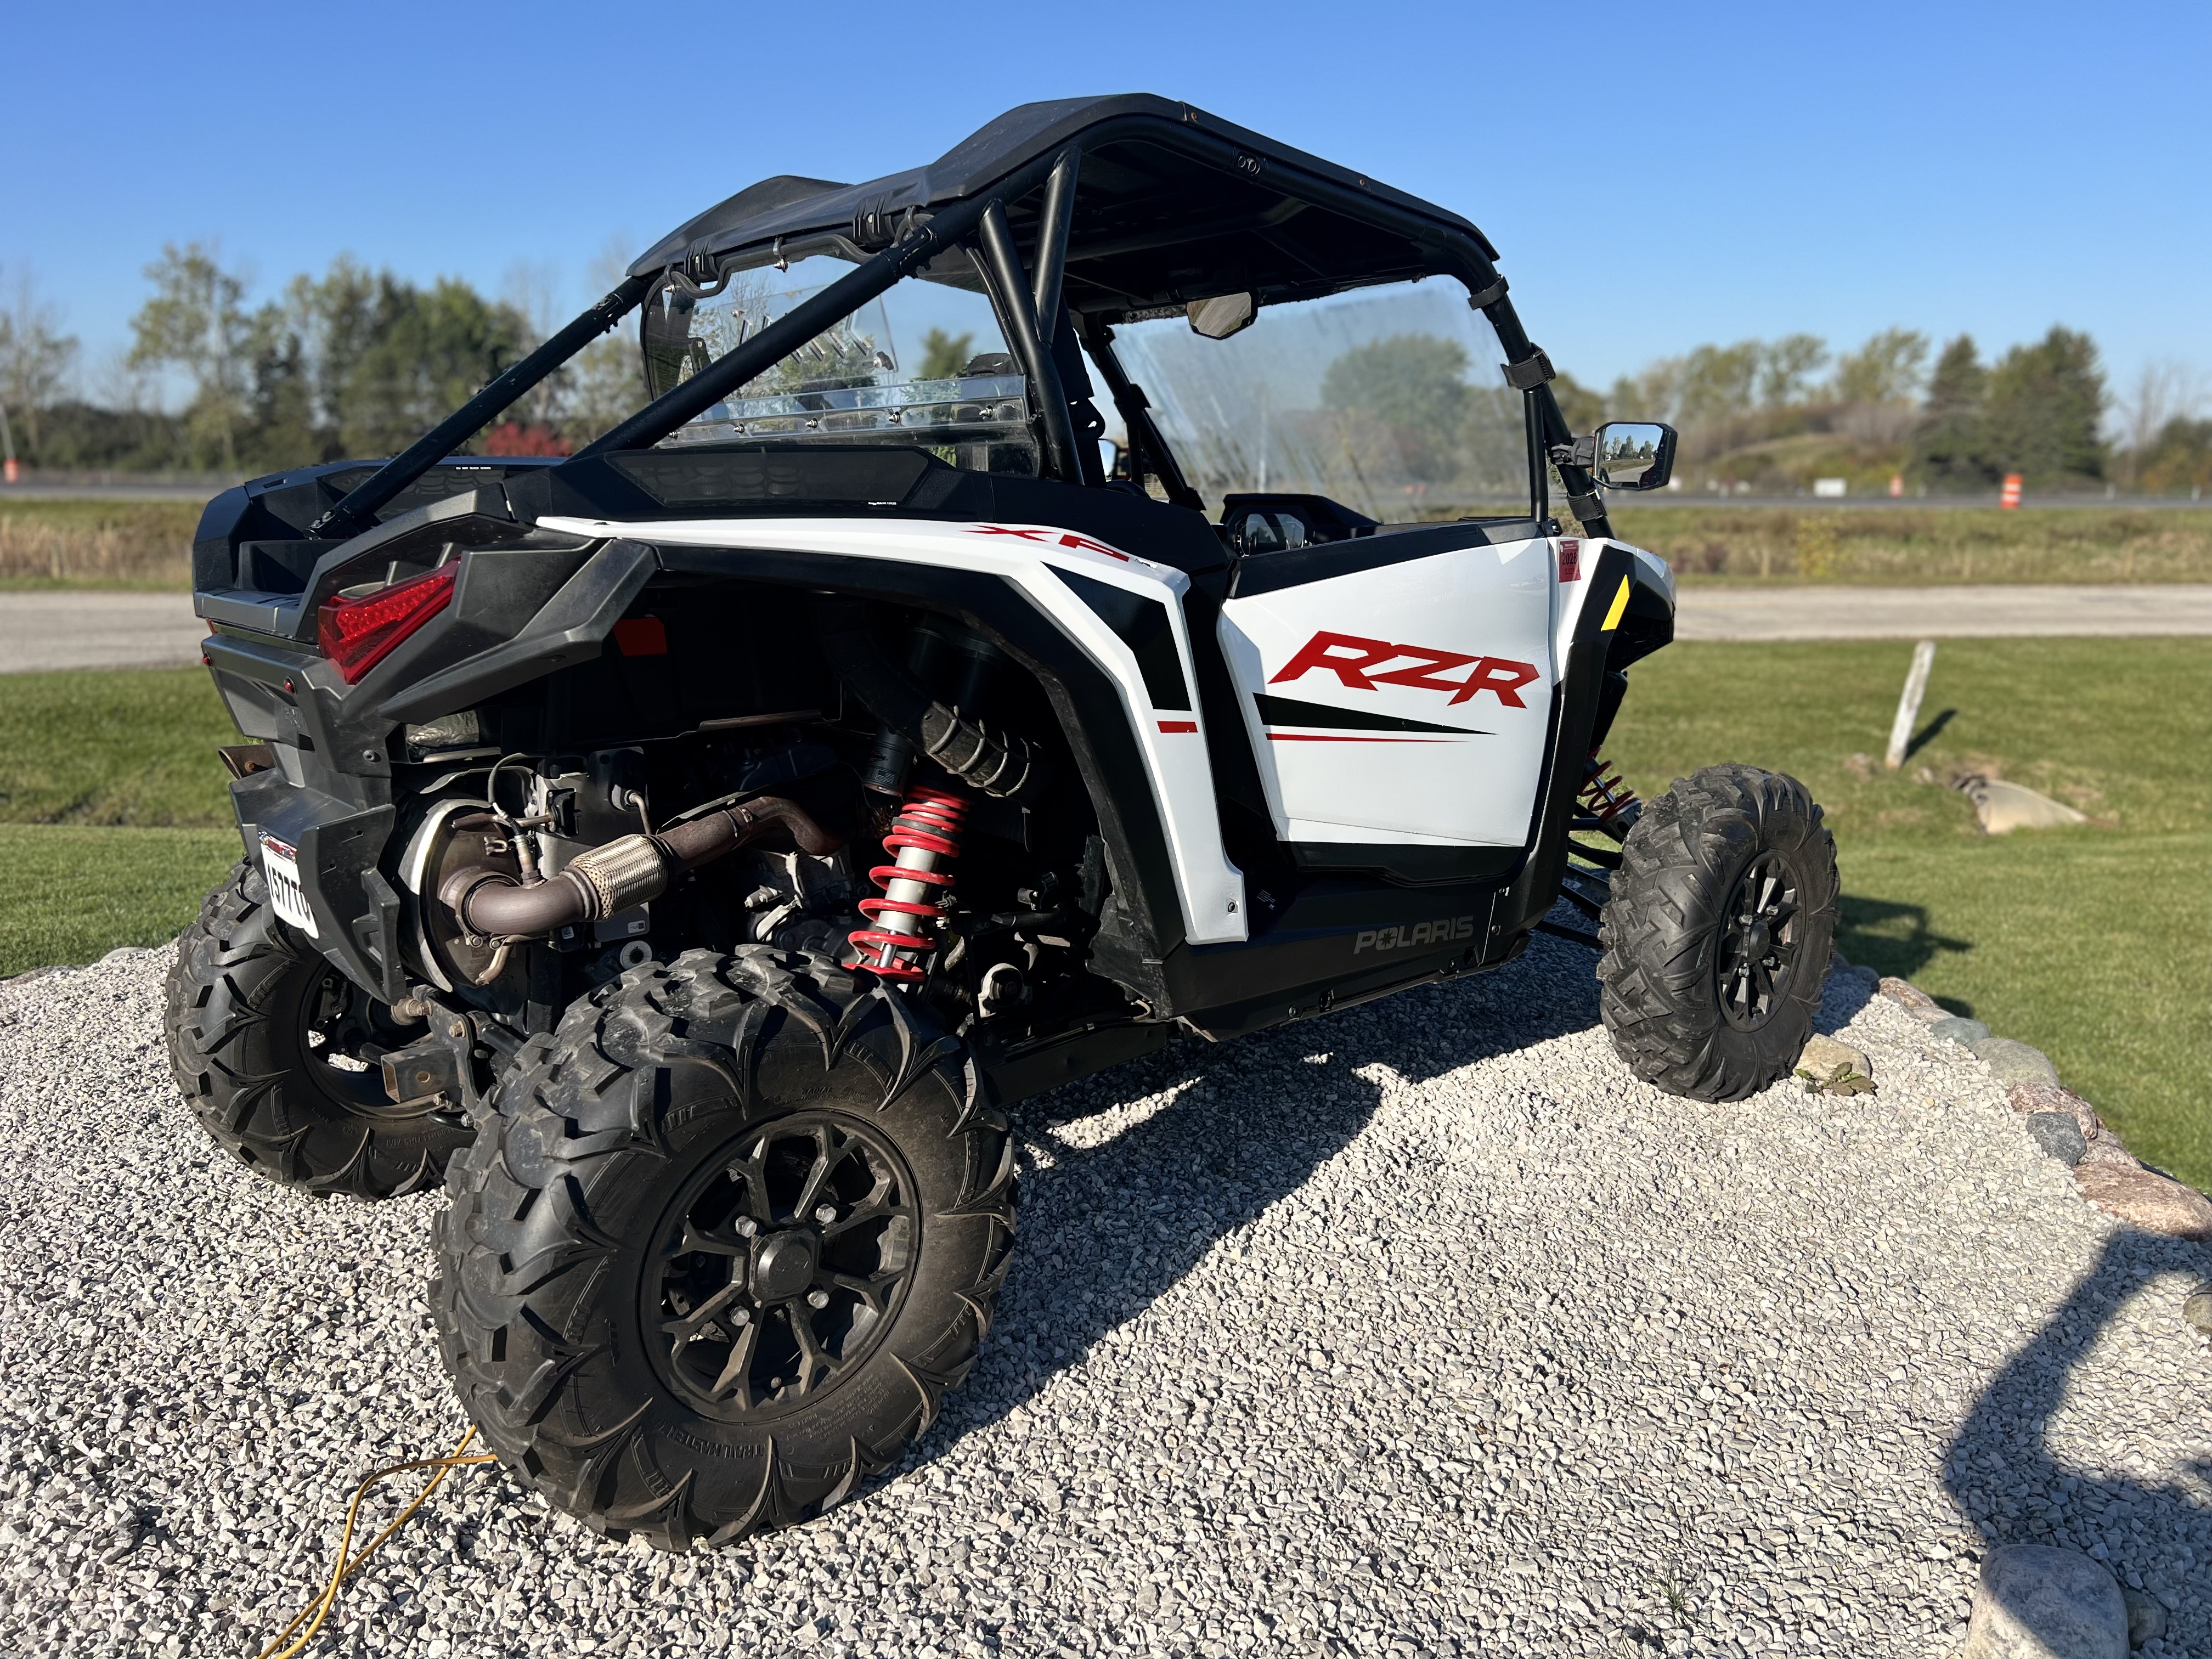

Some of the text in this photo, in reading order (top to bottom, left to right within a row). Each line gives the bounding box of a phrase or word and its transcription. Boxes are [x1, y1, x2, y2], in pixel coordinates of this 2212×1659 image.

[957, 524, 1130, 562] XP
[1562, 552, 1577, 565] 2028
[1268, 630, 1540, 708] RZR
[1353, 915, 1474, 955] POLARIS
